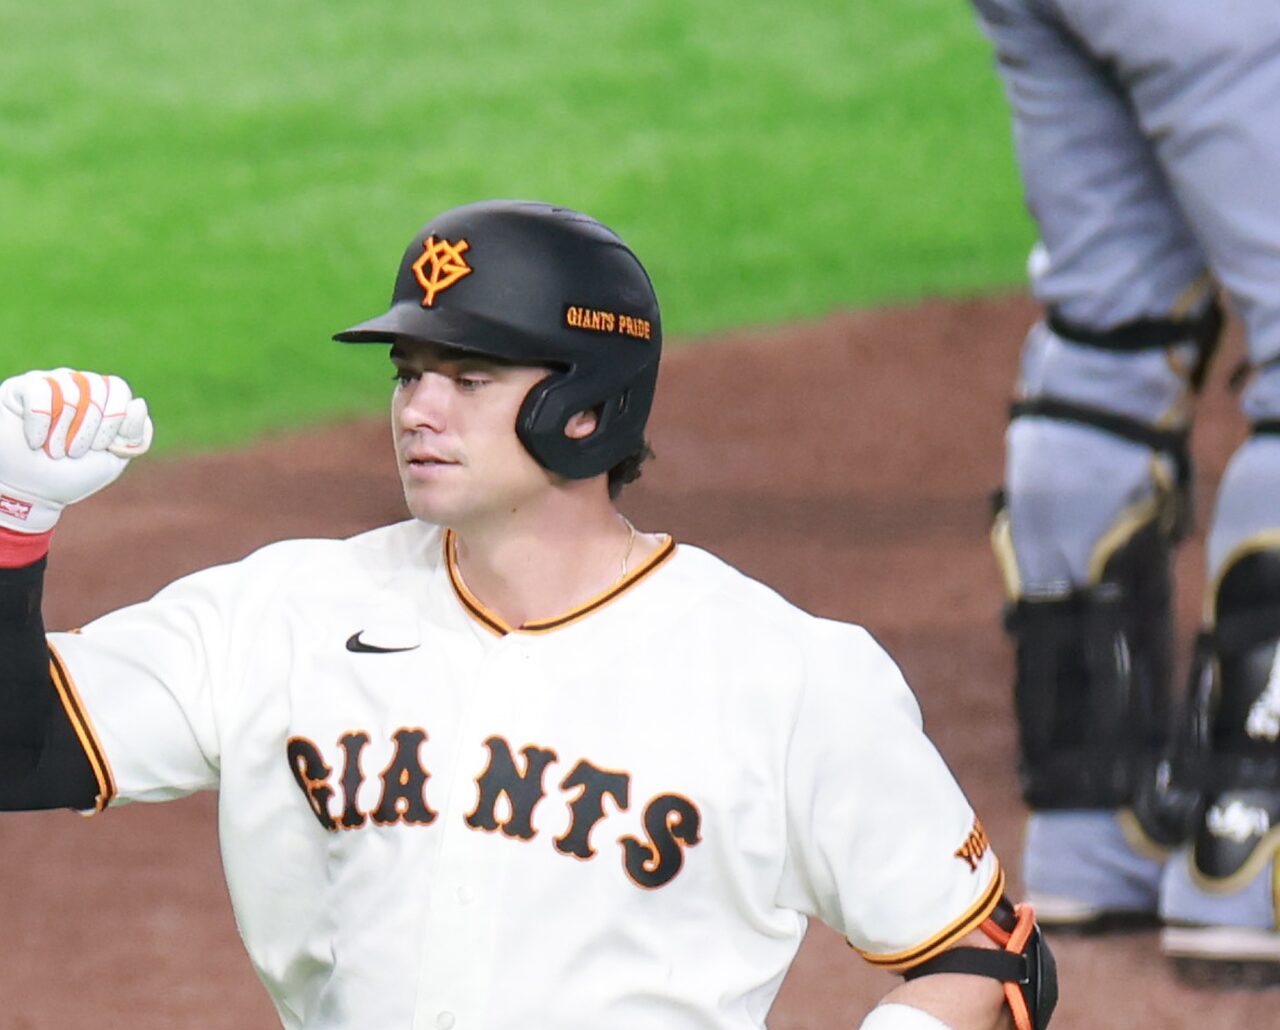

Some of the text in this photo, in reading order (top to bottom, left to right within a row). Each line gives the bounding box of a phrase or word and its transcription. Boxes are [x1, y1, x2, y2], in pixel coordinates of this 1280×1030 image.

[567, 306, 651, 340] GIANTS PRIDE
[286, 726, 702, 890] GIANTS
